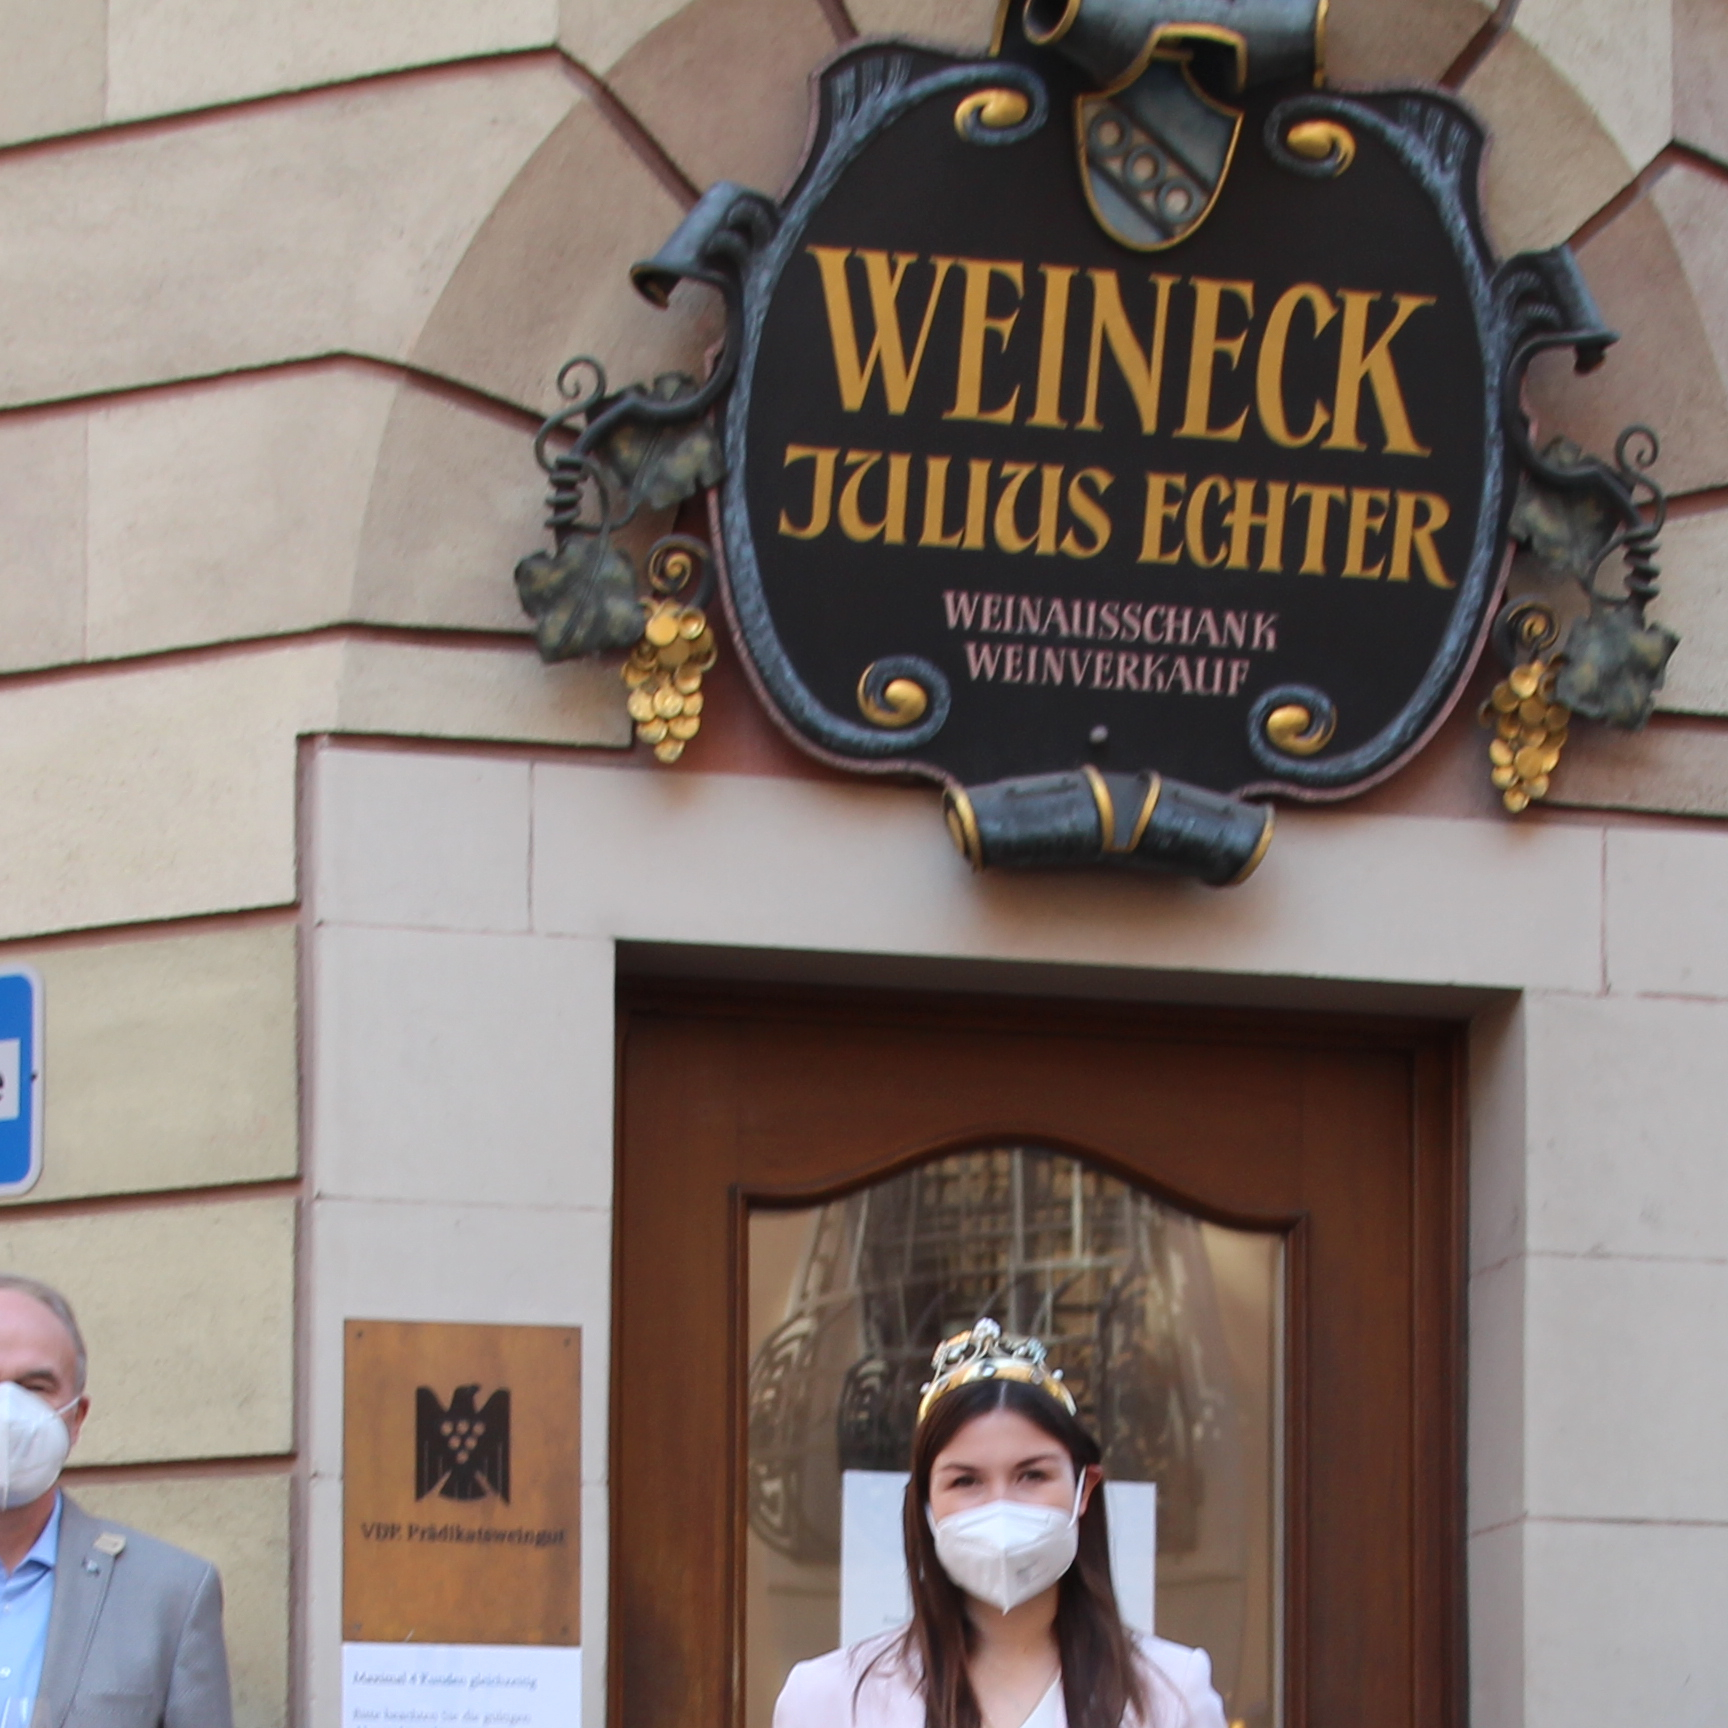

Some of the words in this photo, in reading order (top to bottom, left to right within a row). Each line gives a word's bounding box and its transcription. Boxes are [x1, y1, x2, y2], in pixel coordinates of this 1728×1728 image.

[806, 245, 1437, 458] WEINECK
[778, 443, 1115, 558] JULIUS
[1137, 470, 1456, 589] ECHTER
[943, 589, 1280, 651] WEINAUSSCHANK
[964, 641, 1250, 697] WEINVERKAUF
